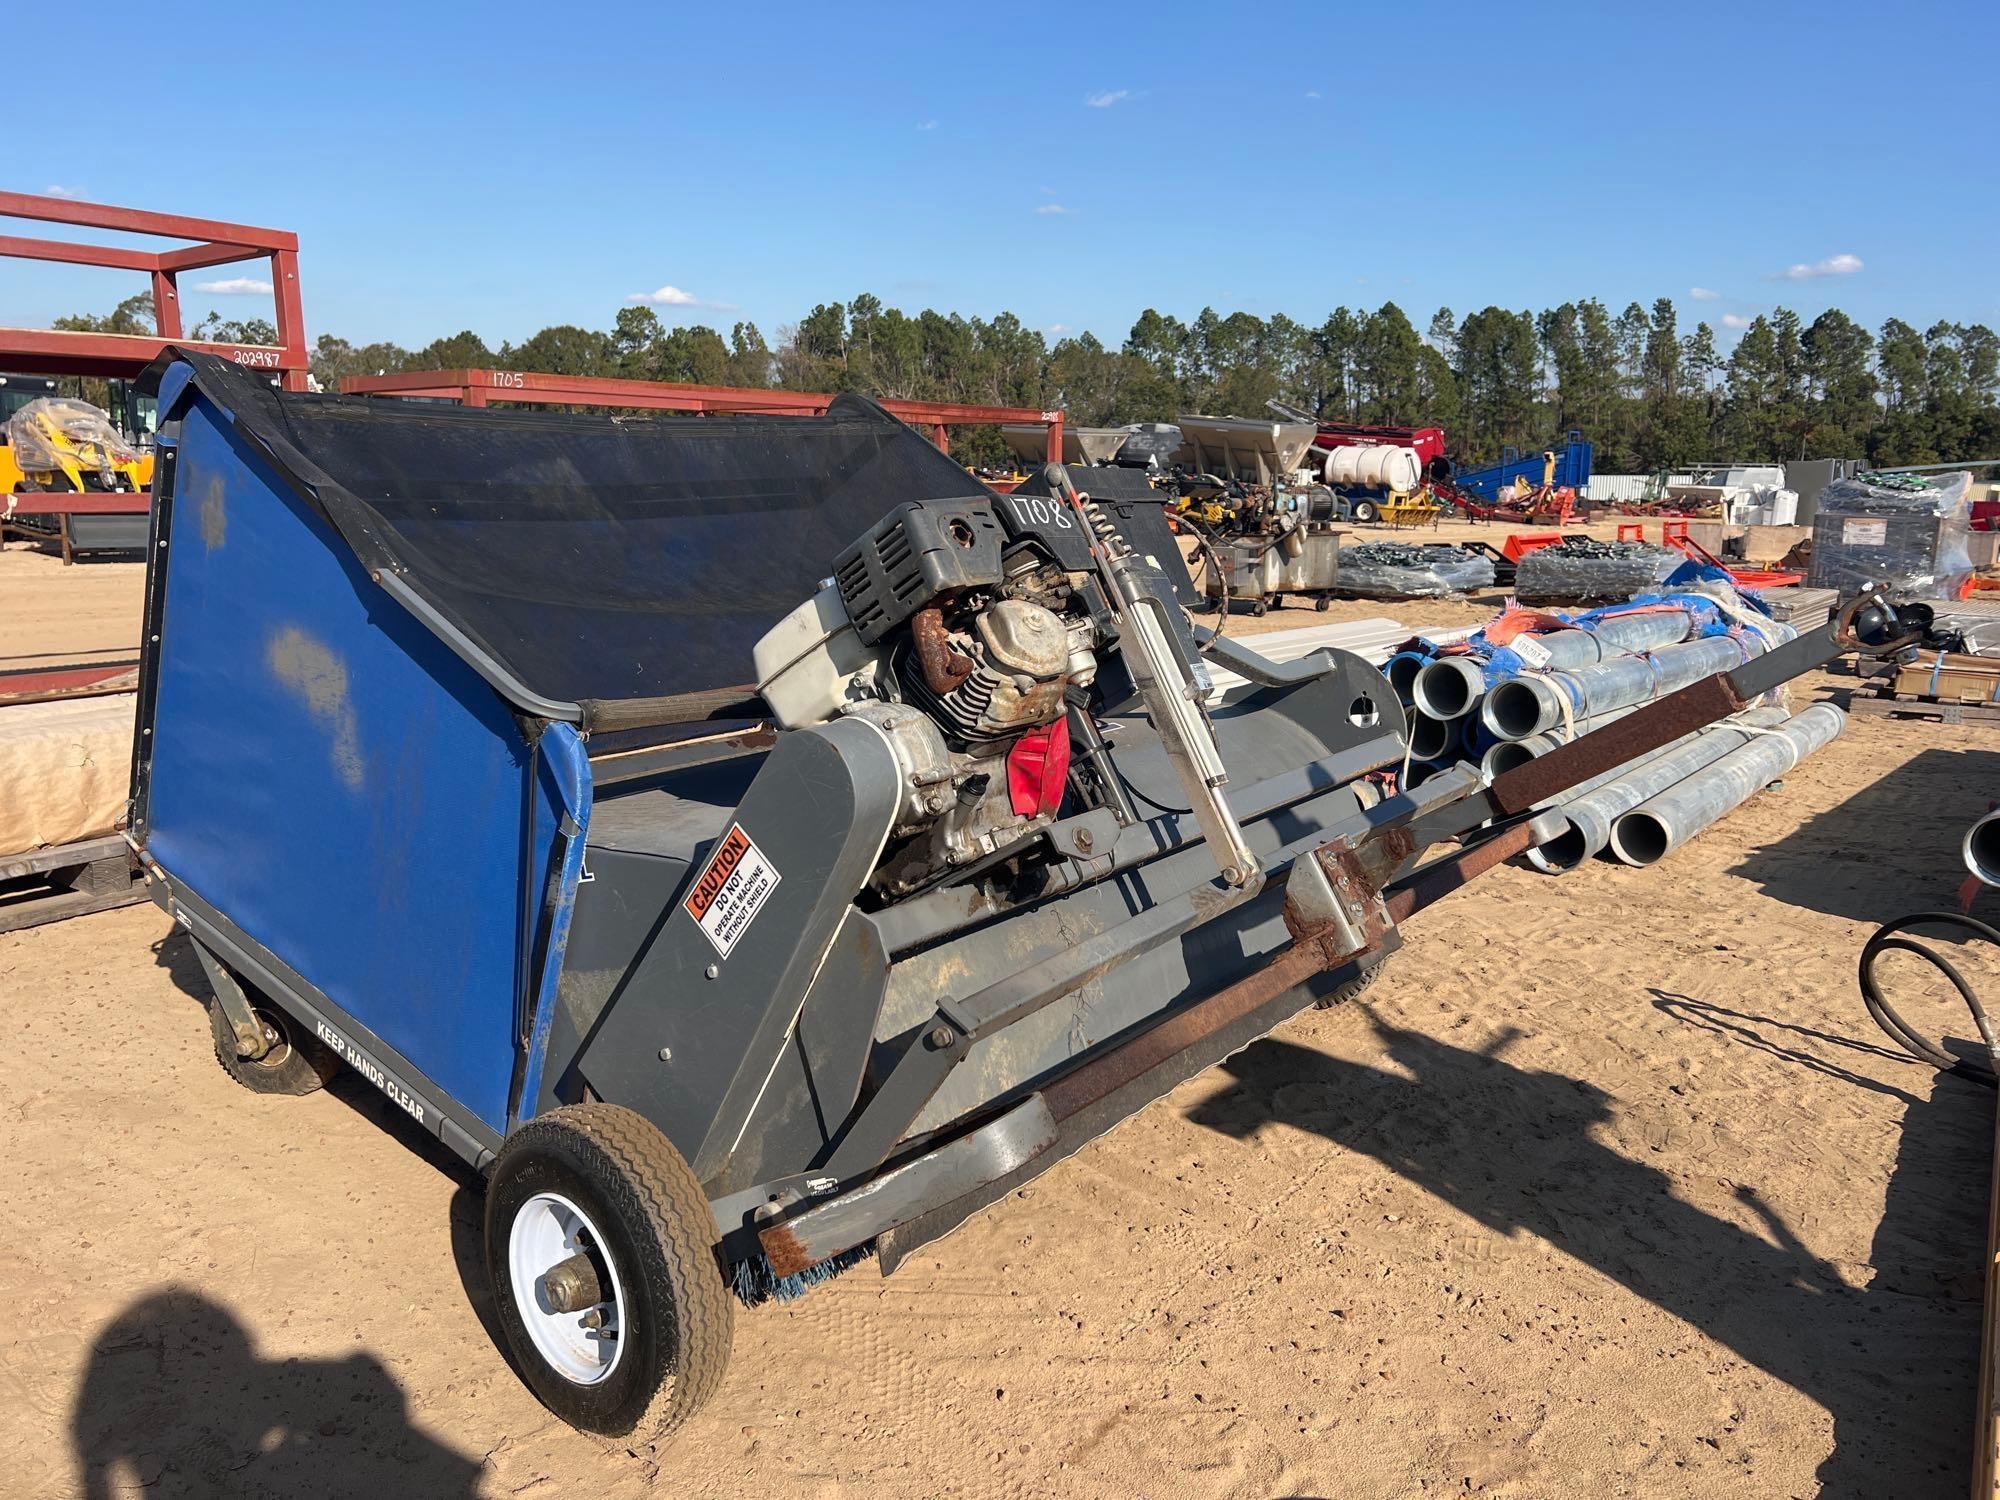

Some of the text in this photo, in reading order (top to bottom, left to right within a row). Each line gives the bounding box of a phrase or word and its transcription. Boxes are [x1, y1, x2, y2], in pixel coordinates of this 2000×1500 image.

[233, 350, 280, 367] 202987
[493, 372, 524, 388] 1705
[1009, 497, 1072, 529] 1708
[692, 835, 744, 911] CAUTION
[715, 869, 744, 911] DO NOT
[714, 865, 764, 937] OPERATE MACHINE
[722, 878, 769, 943] WITHOUT SHIELD
[317, 1020, 424, 1124] KEEP HANDS CLEAR
